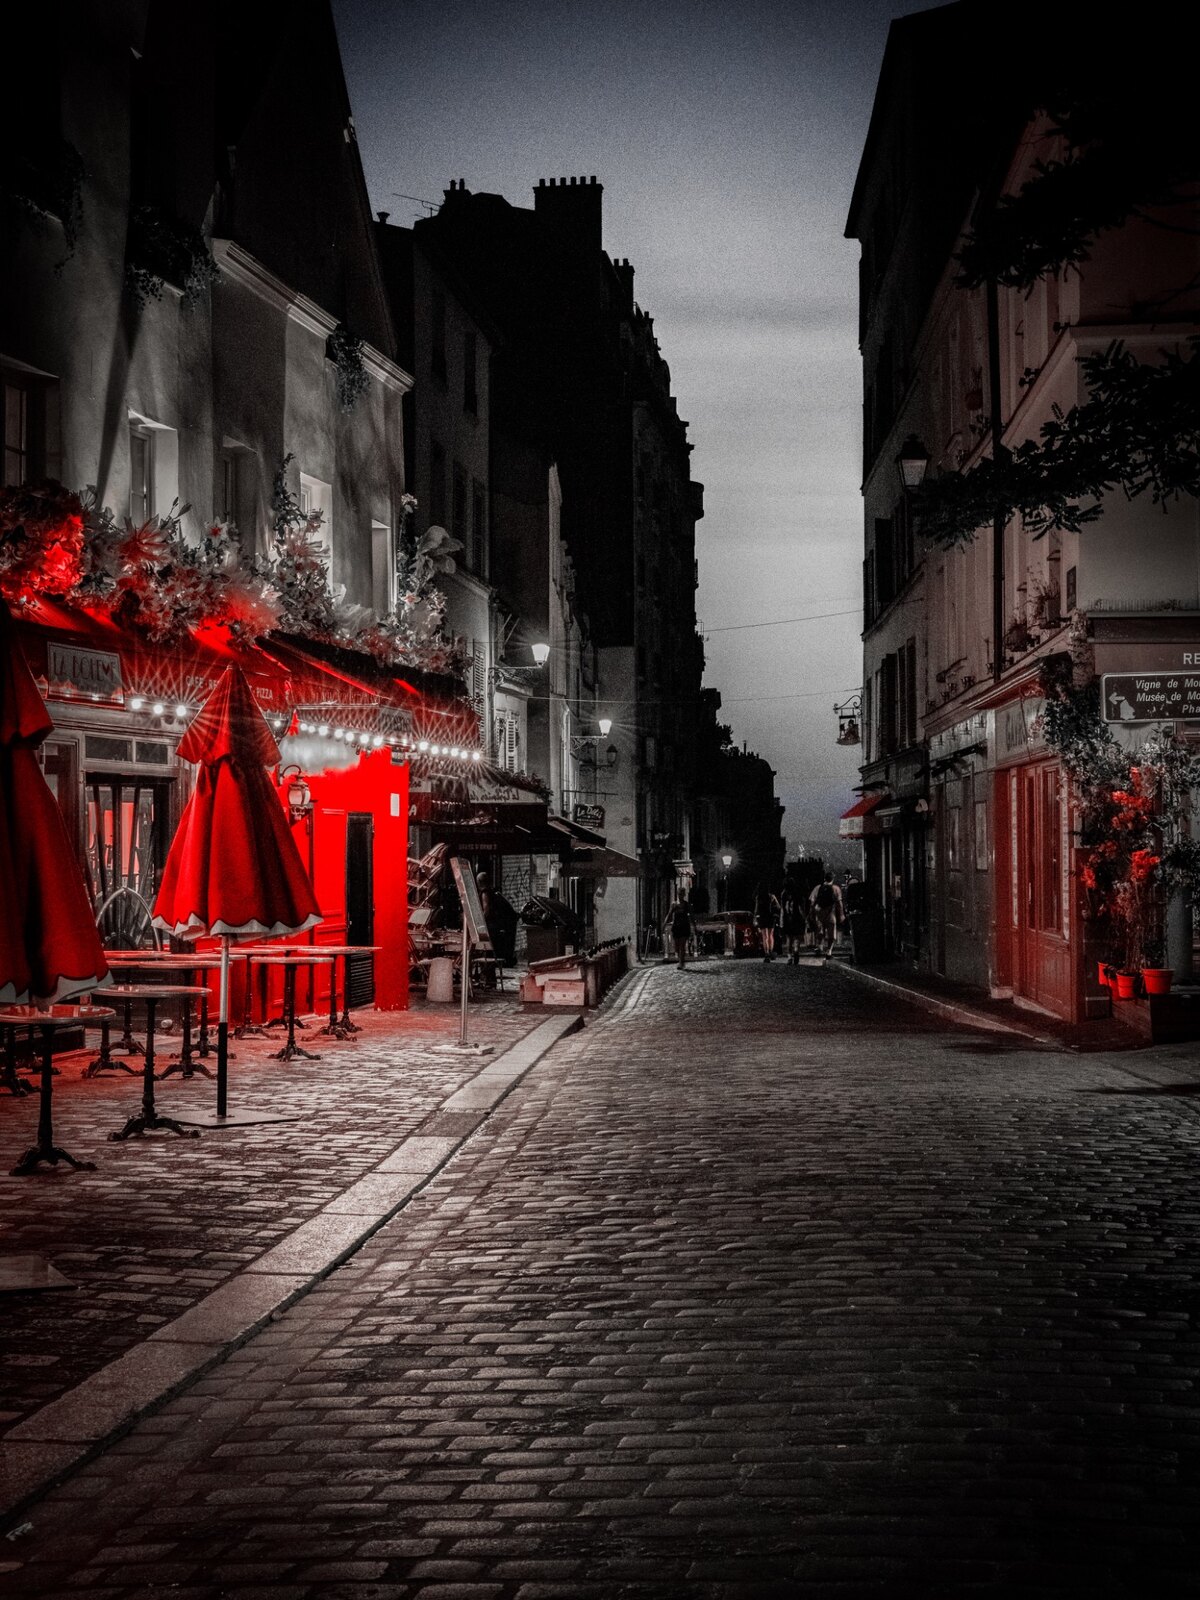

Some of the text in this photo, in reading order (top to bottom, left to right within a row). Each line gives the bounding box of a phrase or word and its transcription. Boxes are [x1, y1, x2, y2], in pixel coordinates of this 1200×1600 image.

[1135, 678, 1200, 691] Vigne de Mo
[255, 686, 274, 701] PIZZA
[1136, 692, 1166, 702] Musée
[1170, 692, 1182, 701] de
